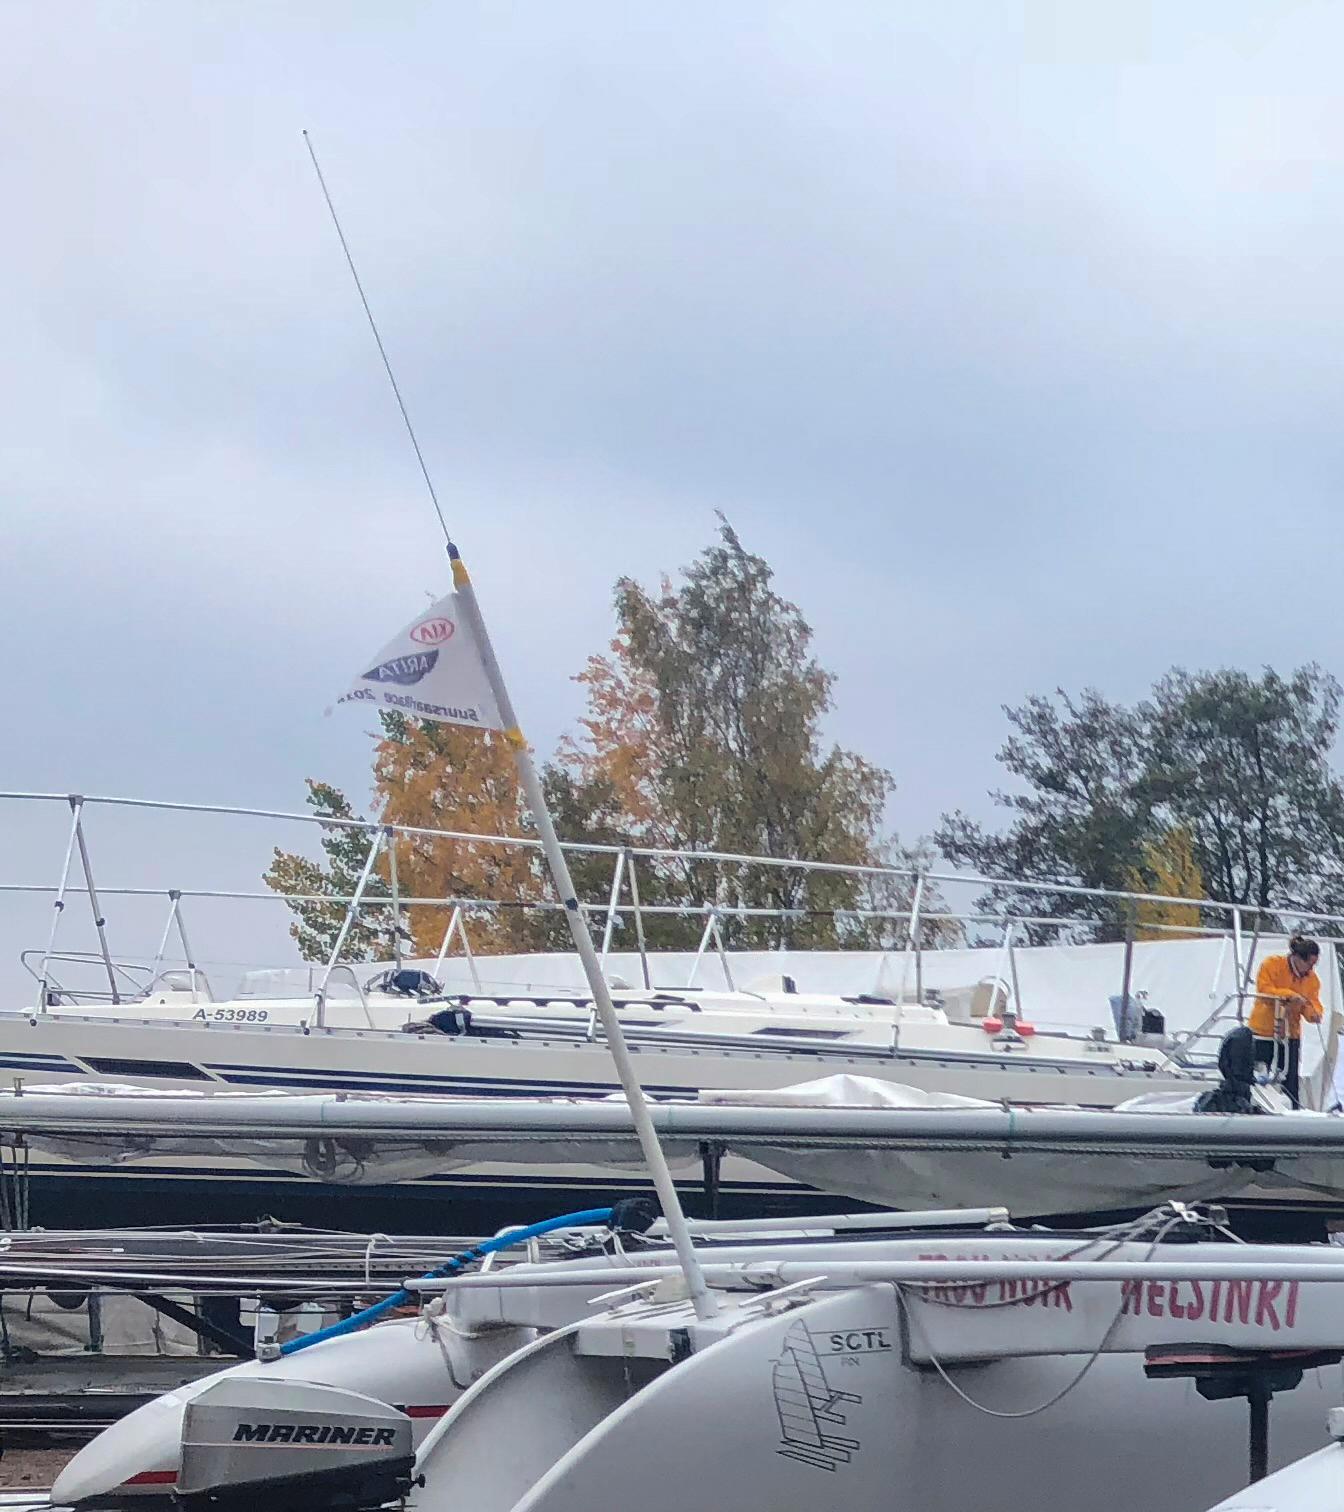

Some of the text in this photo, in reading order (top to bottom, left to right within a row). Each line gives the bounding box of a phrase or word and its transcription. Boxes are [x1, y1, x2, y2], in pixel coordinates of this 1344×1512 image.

[192, 1008, 269, 1022] A-53989
[830, 1331, 893, 1352] SCTL
[232, 1423, 397, 1446] MARINER
